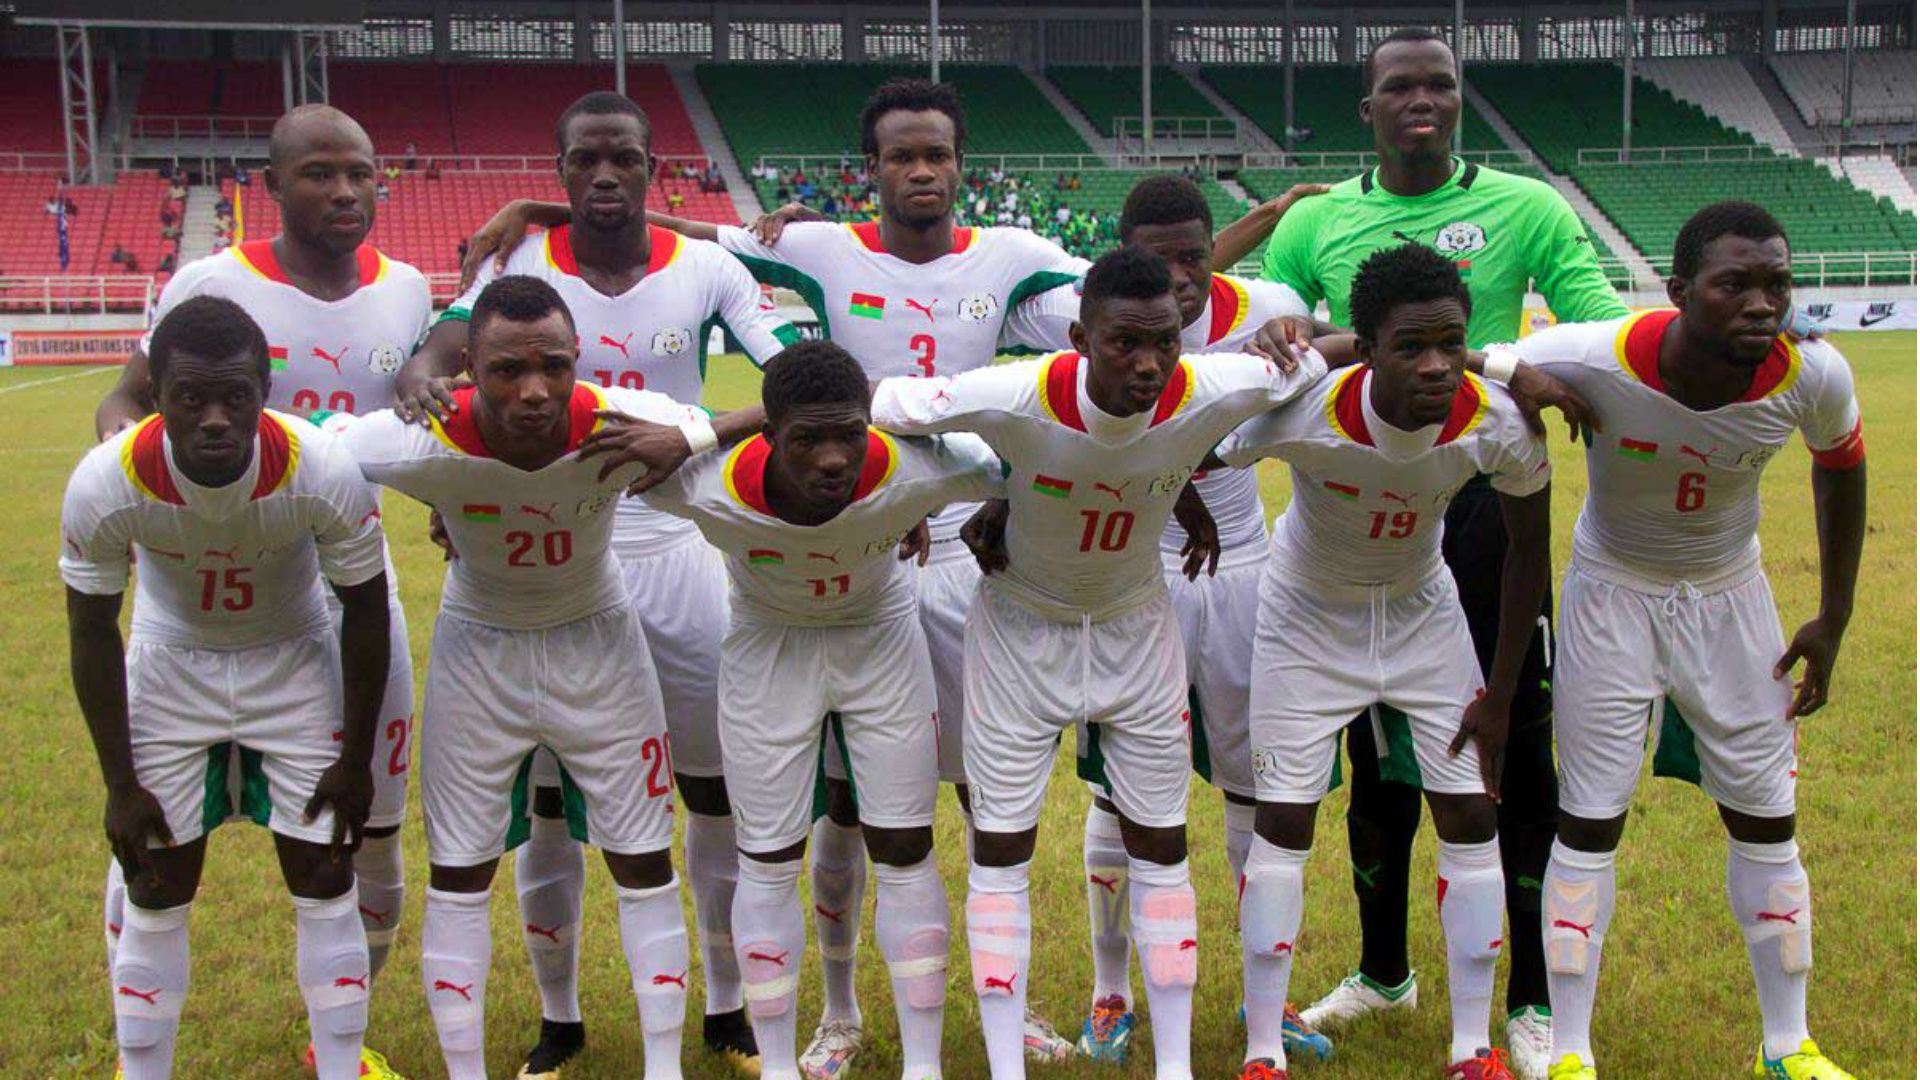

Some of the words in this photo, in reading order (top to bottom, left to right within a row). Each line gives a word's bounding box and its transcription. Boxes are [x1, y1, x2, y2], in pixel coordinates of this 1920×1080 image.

[1808, 304, 1832, 317] NIKE
[1867, 303, 1895, 316] NIKE
[41, 339, 80, 354] AFRICAN
[83, 338, 121, 353] NATIONS
[909, 333, 937, 378] 3
[1676, 473, 1706, 512] 6
[1079, 510, 1135, 552] 10
[1368, 511, 1418, 539] 19
[505, 529, 573, 567] 20
[196, 567, 254, 612] 15
